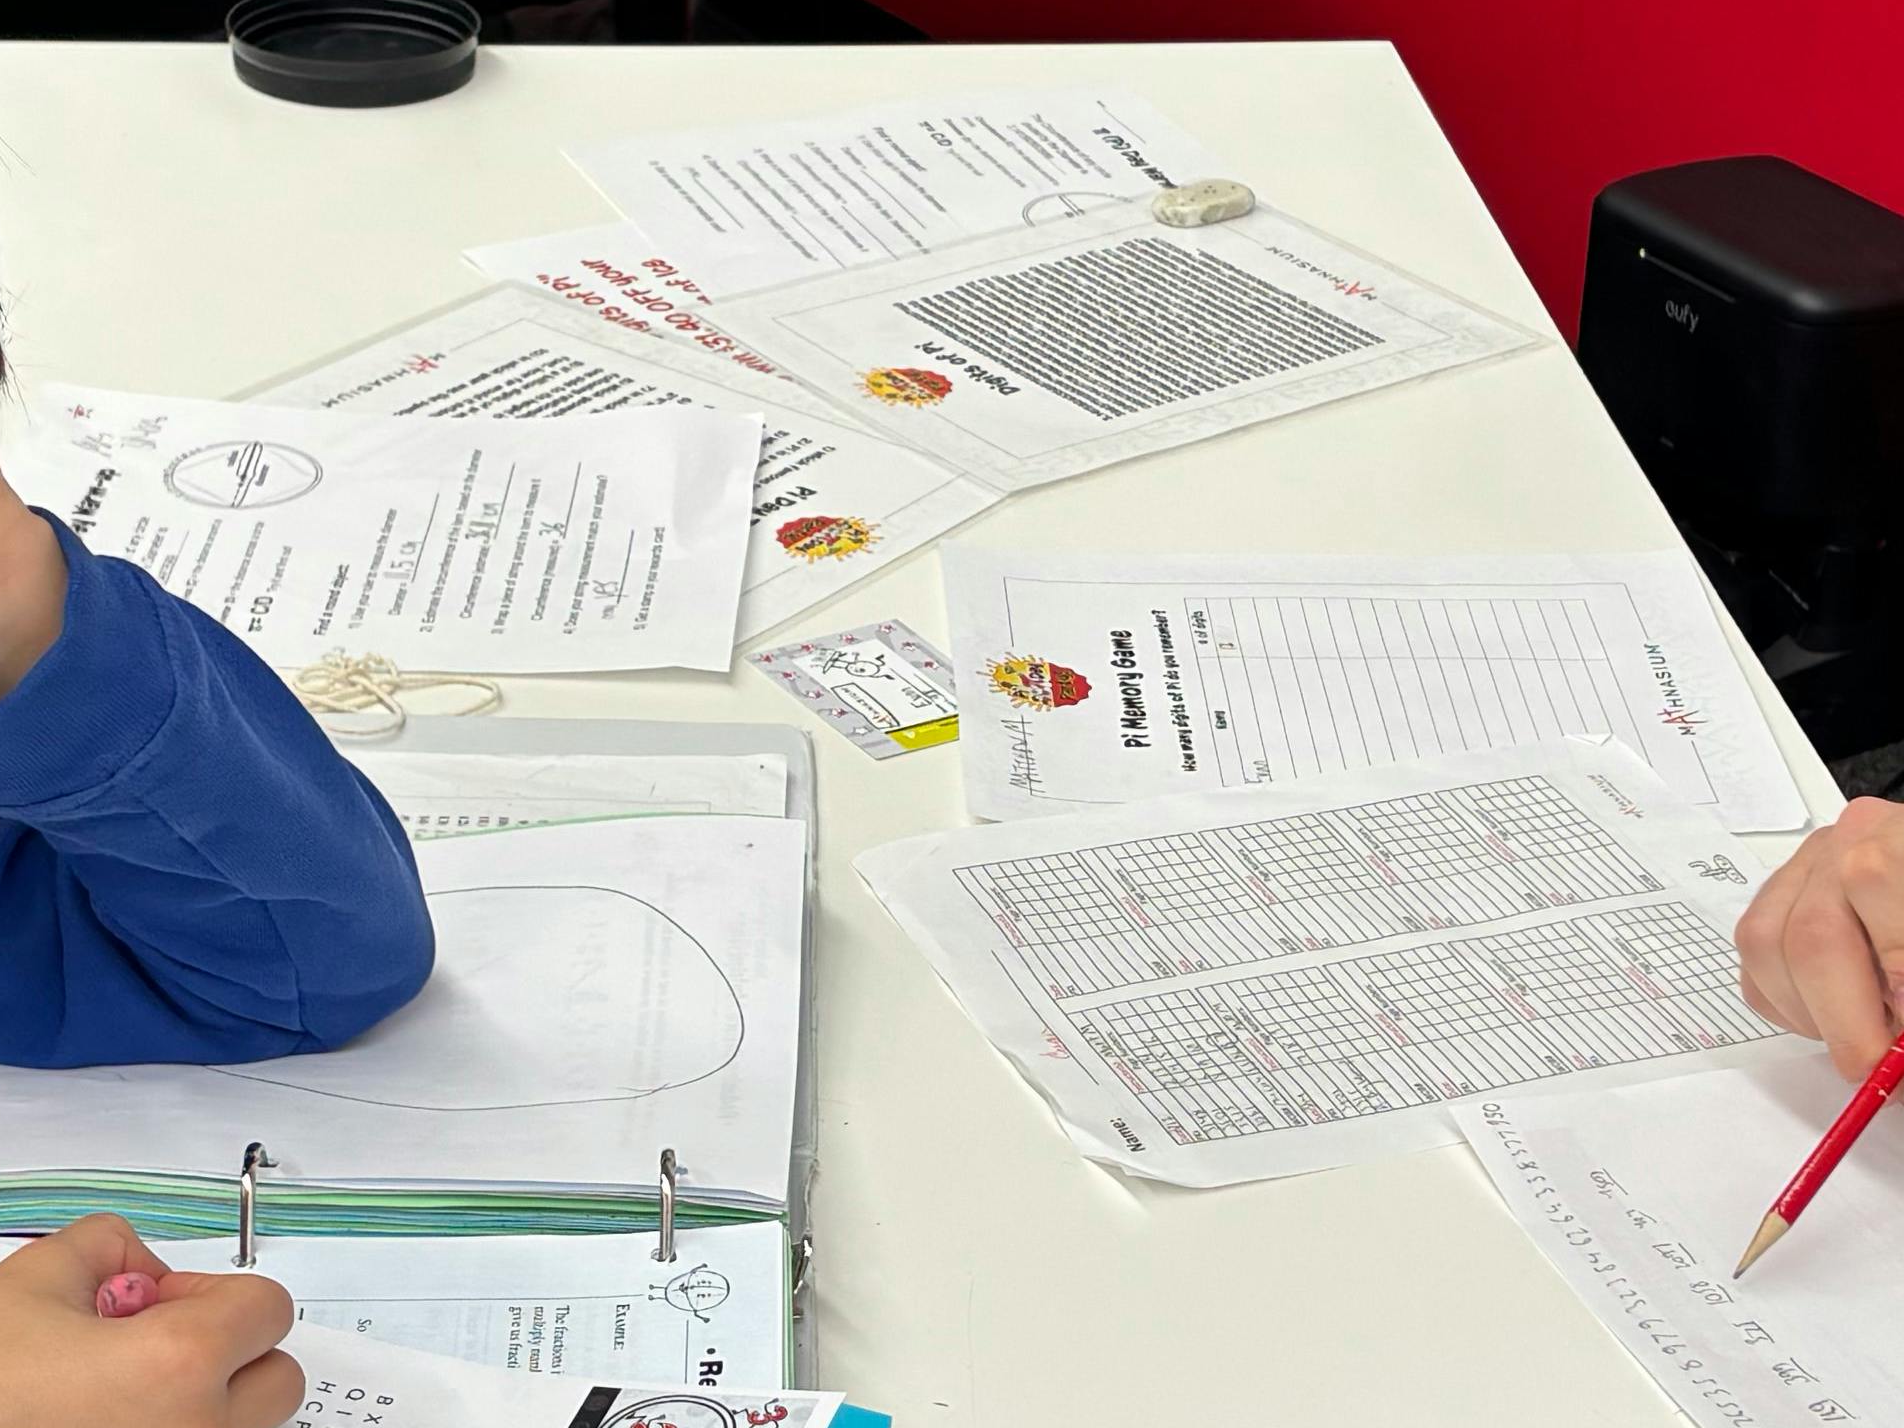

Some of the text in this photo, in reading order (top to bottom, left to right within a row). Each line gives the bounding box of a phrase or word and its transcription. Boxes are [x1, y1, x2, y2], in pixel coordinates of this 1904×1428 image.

[914, 341, 1021, 396] Digits of Pi
[1110, 630, 1151, 748] Pi Memory Game
[1110, 1118, 1146, 1152] Name:
[555, 1305, 570, 1324] The
